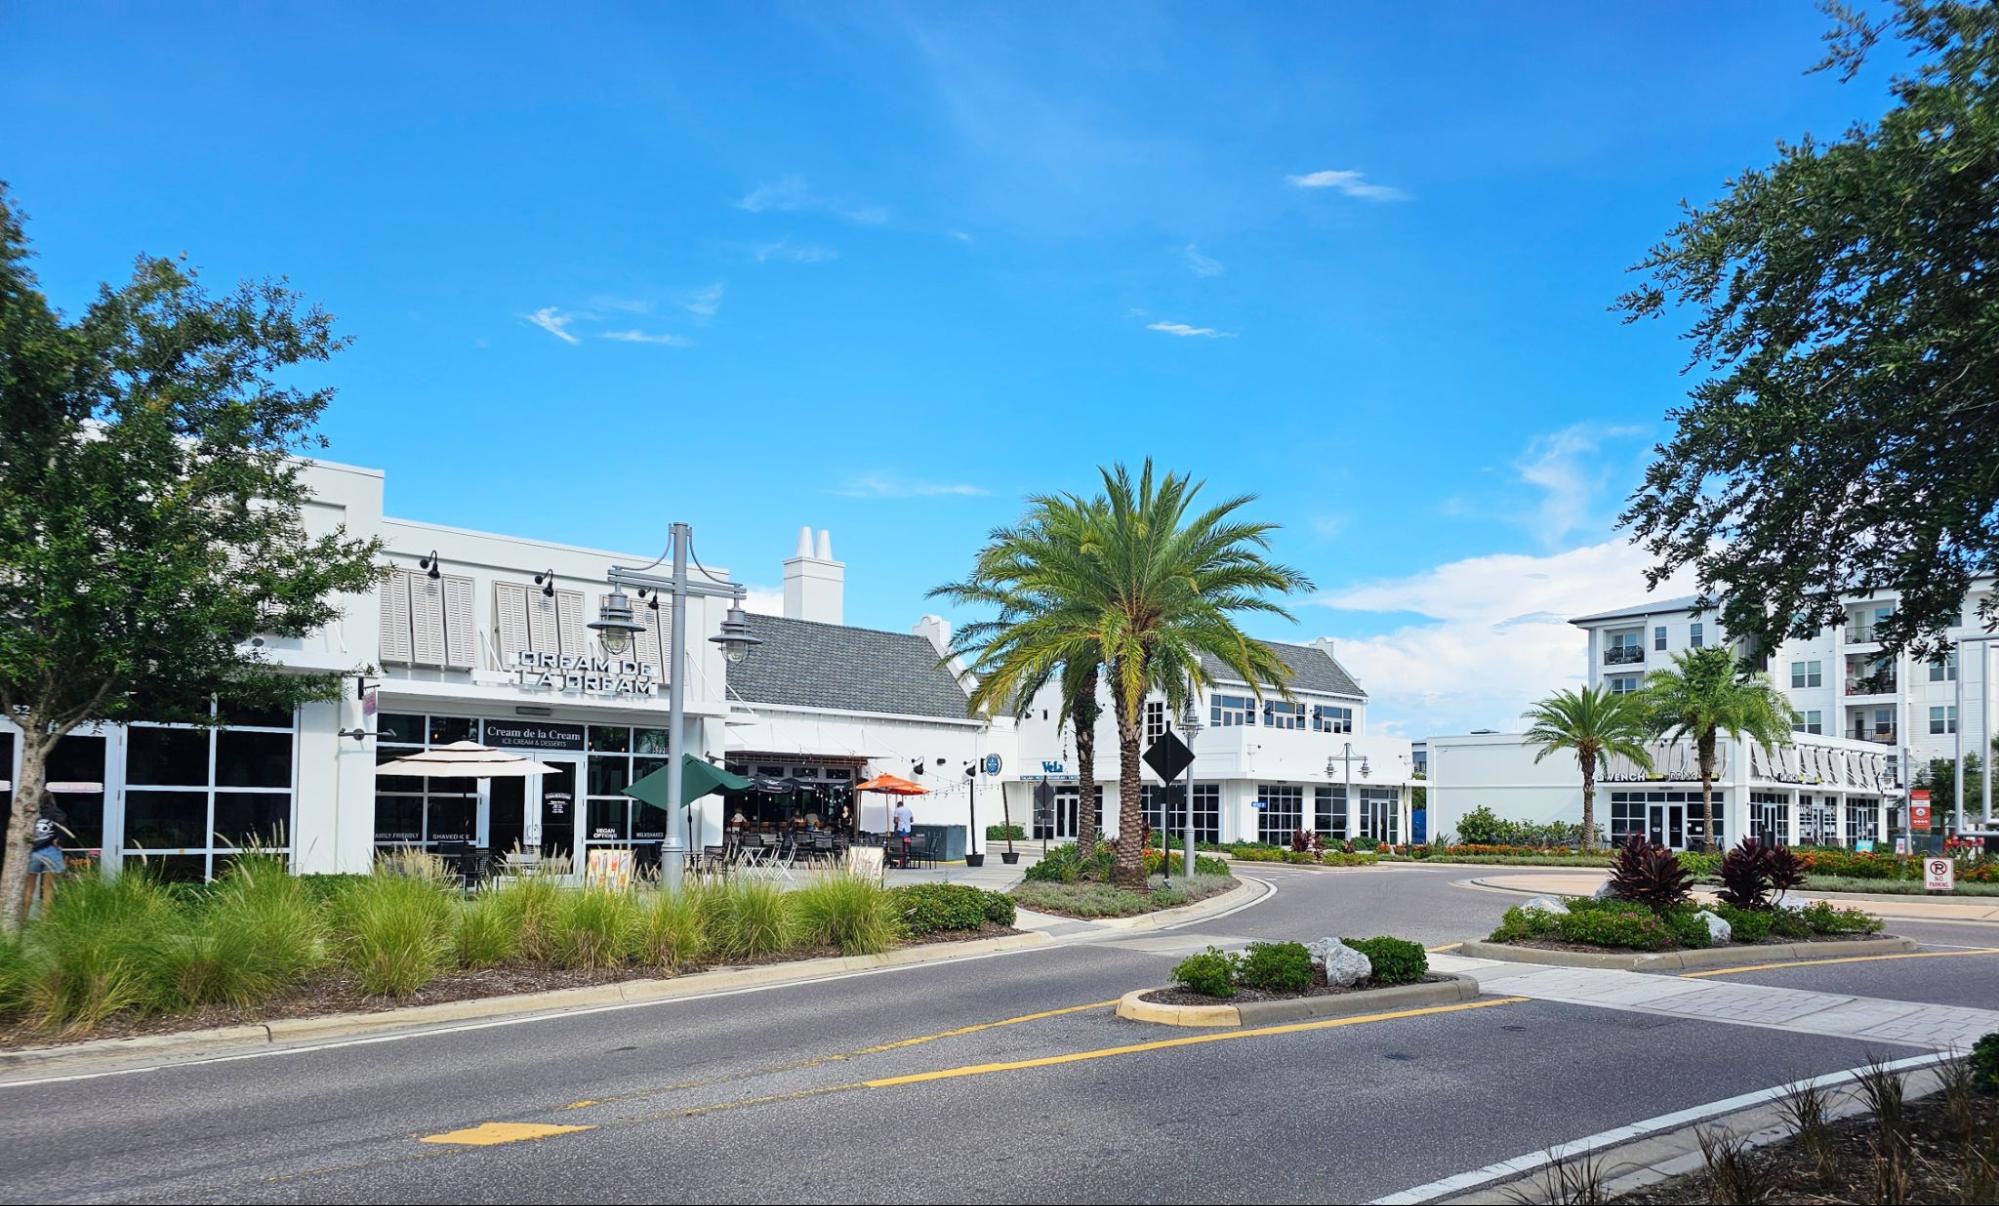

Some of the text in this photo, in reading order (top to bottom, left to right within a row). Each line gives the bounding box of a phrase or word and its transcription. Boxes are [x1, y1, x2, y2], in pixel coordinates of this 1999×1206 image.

[520, 651, 611, 673] CREAM
[521, 671, 652, 695] LA CREAM
[487, 726, 581, 741] Cream de la Cream
[502, 737, 512, 745] ICE
[540, 740, 566, 748] DESSERTS
